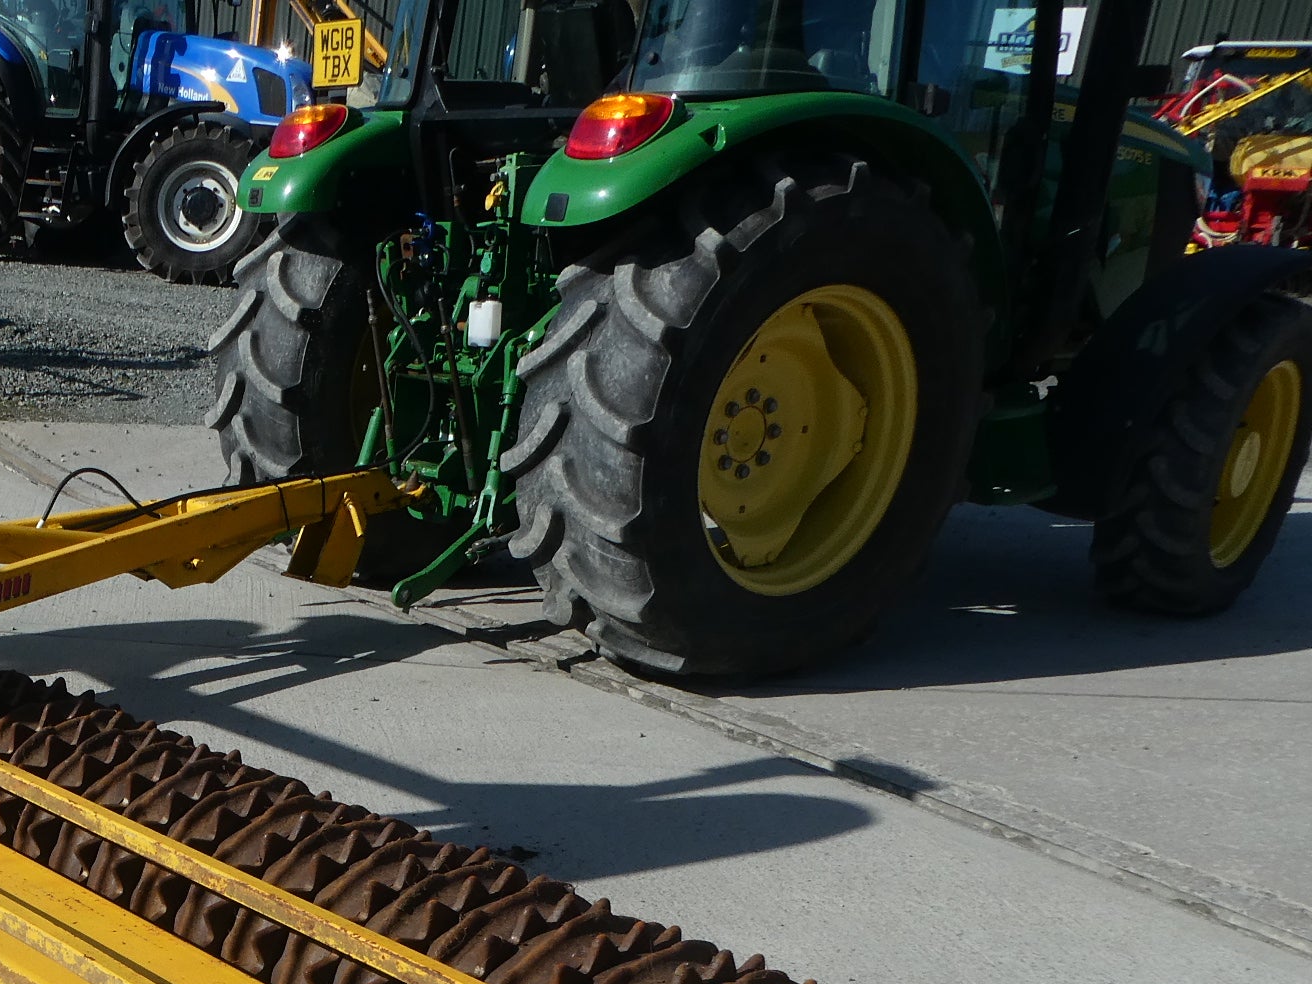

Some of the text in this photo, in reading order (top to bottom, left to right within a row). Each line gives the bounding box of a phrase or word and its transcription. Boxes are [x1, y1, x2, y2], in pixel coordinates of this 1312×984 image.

[321, 27, 354, 52] WG18
[322, 54, 352, 79] TBX
[158, 82, 209, 101] New Holland
